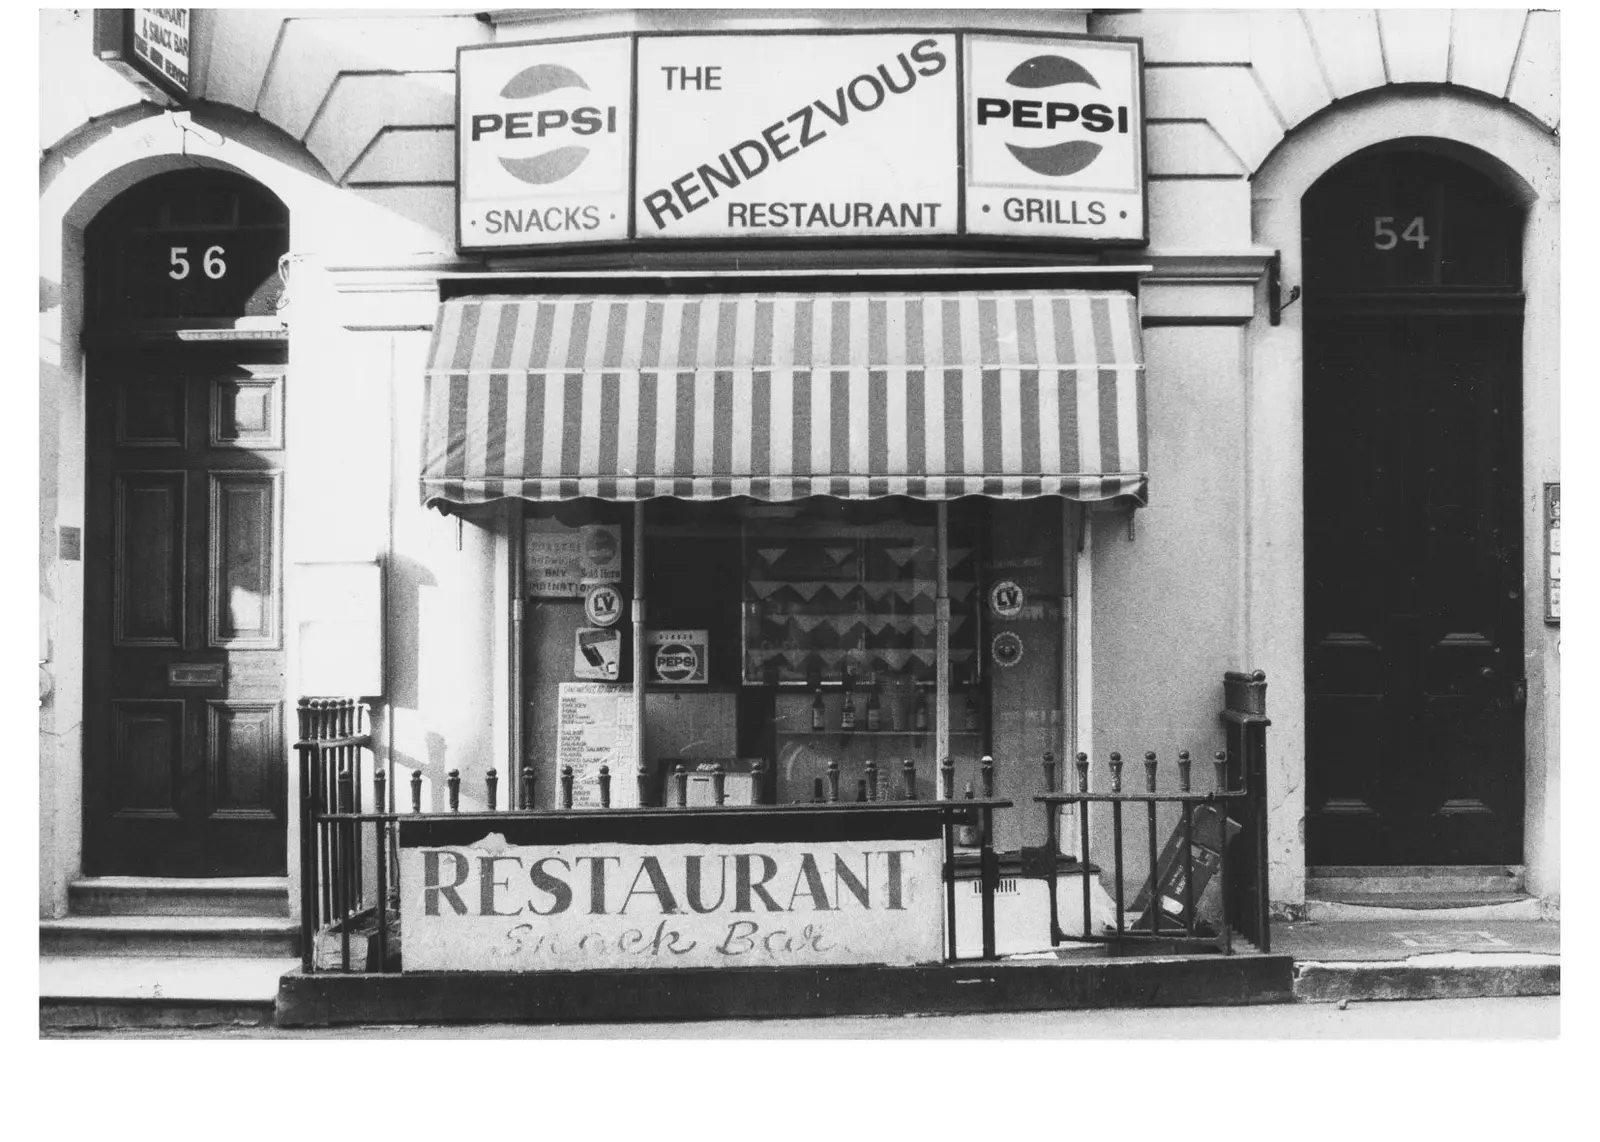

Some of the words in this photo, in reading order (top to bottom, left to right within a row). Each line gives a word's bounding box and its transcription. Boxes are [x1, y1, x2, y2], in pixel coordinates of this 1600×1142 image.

[149, 20, 171, 51] SNACK
[173, 32, 188, 57] BAR
[661, 66, 721, 90] THE
[471, 107, 617, 142] PEPSI
[977, 97, 1128, 134] PEPSI
[644, 38, 948, 229] RENDEZVOUS
[484, 204, 600, 234] SNACKS
[728, 202, 941, 228] RESTAURANT
[1003, 197, 1106, 225] GRILLS
[1374, 216, 1430, 250] 54
[169, 246, 226, 280] 56
[657, 656, 696, 667] PEPSI
[420, 849, 915, 917] RESTAURANT
[715, 920, 834, 956] Bar
